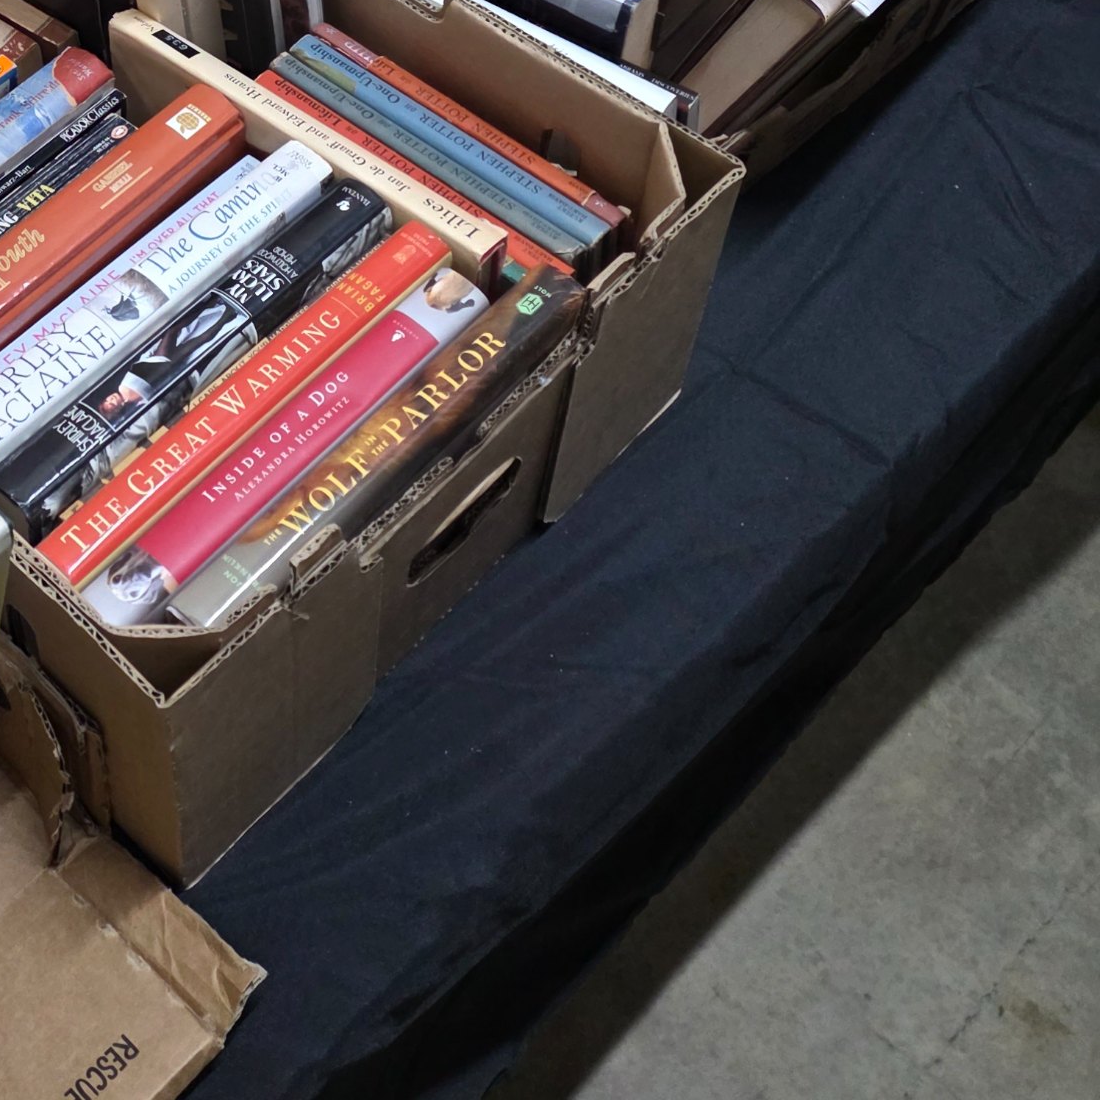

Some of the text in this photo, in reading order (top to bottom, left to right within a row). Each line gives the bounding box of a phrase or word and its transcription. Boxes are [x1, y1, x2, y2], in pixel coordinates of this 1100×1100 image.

[223, 72, 263, 101] Hyams
[261, 97, 307, 129] Edward
[305, 125, 331, 141] and
[327, 135, 368, 167] Graaff
[369, 162, 387, 178] de
[387, 174, 412, 194] Jan
[16, 181, 57, 213] VITA
[422, 195, 481, 240] Lilies
[336, 282, 374, 314] BRIAN
[363, 331, 508, 448] IN PARLOR
[59, 497, 130, 556] THE
[126, 416, 219, 498] GREAT
[210, 308, 342, 417] WARMING
[201, 370, 351, 504] INSIDE OF A DOG
[233, 395, 351, 502] ALEXANDRA HOROWITZ
[263, 444, 368, 547] THE WOLF
